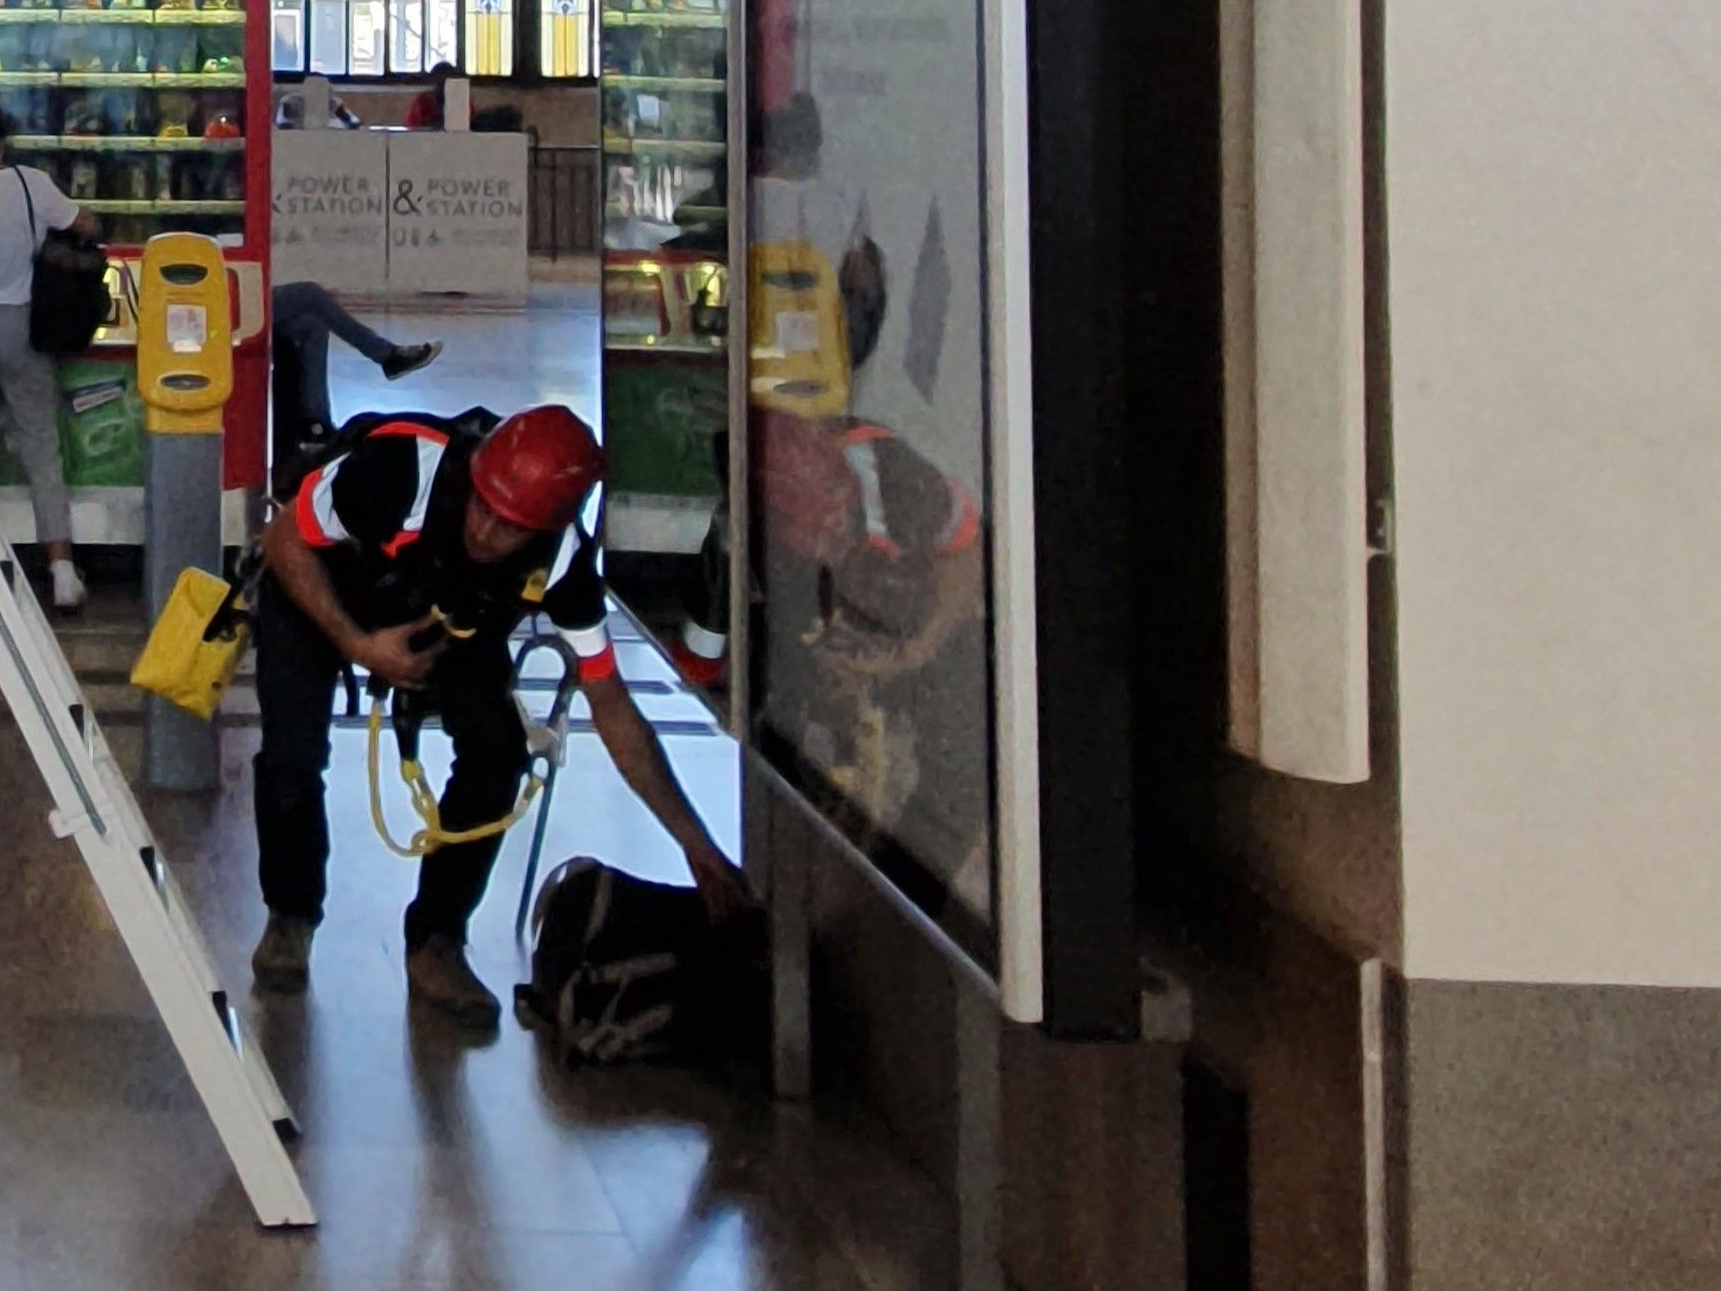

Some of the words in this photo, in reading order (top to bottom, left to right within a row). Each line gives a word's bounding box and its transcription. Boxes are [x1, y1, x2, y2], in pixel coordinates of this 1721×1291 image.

[287, 176, 370, 194] POWER
[426, 178, 511, 197] POWER
[286, 197, 383, 215] STATION
[425, 200, 524, 219] STATION
